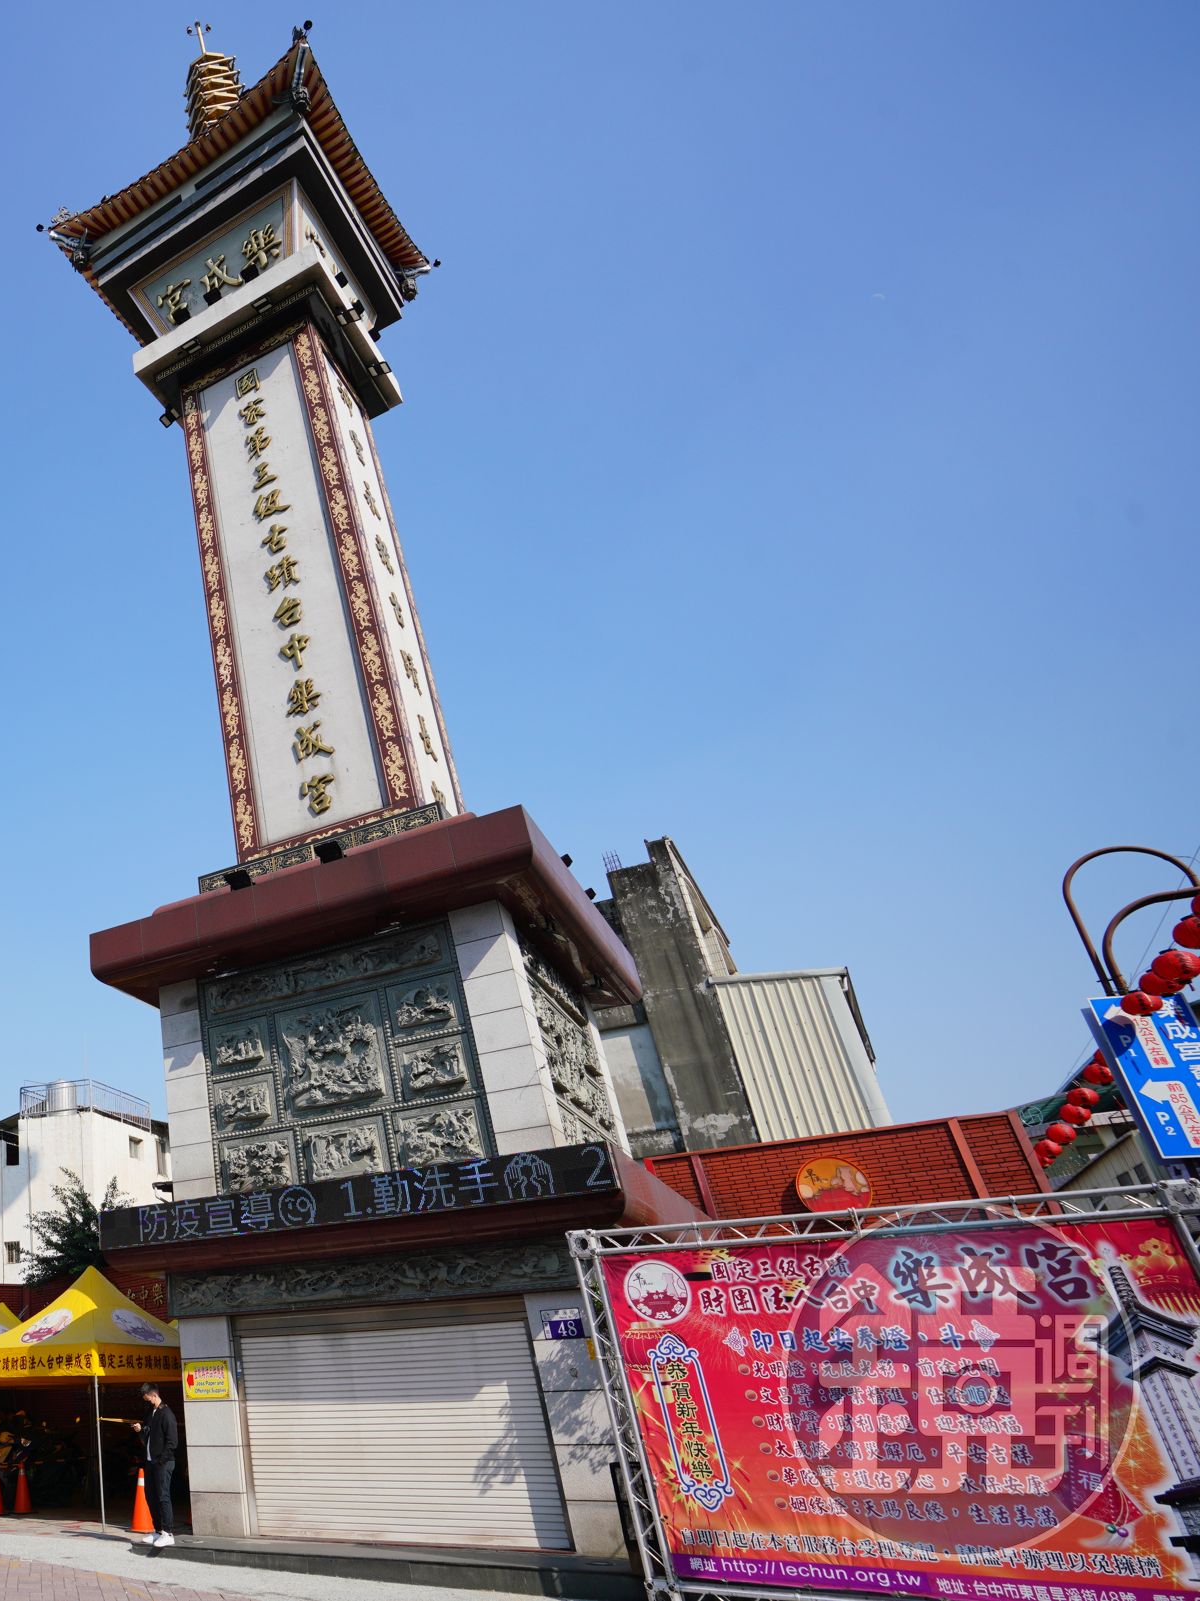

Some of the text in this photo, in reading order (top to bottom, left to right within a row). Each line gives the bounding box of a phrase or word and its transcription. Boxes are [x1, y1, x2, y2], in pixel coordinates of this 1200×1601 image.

[157, 223, 282, 322] 樂成宮
[234, 367, 336, 816] 國家第三級古蹟台中樂成宮
[138, 1189, 276, 1242] 防疫宣導
[340, 1157, 499, 1217] 1.勤洗手
[893, 1242, 1088, 1308] 樂成宮
[557, 1320, 578, 1337] 48
[667, 1362, 713, 1479] 恭賀新年快樂
[689, 1556, 718, 1573] 網址
[781, 1561, 922, 1587] lechun.org.tw
